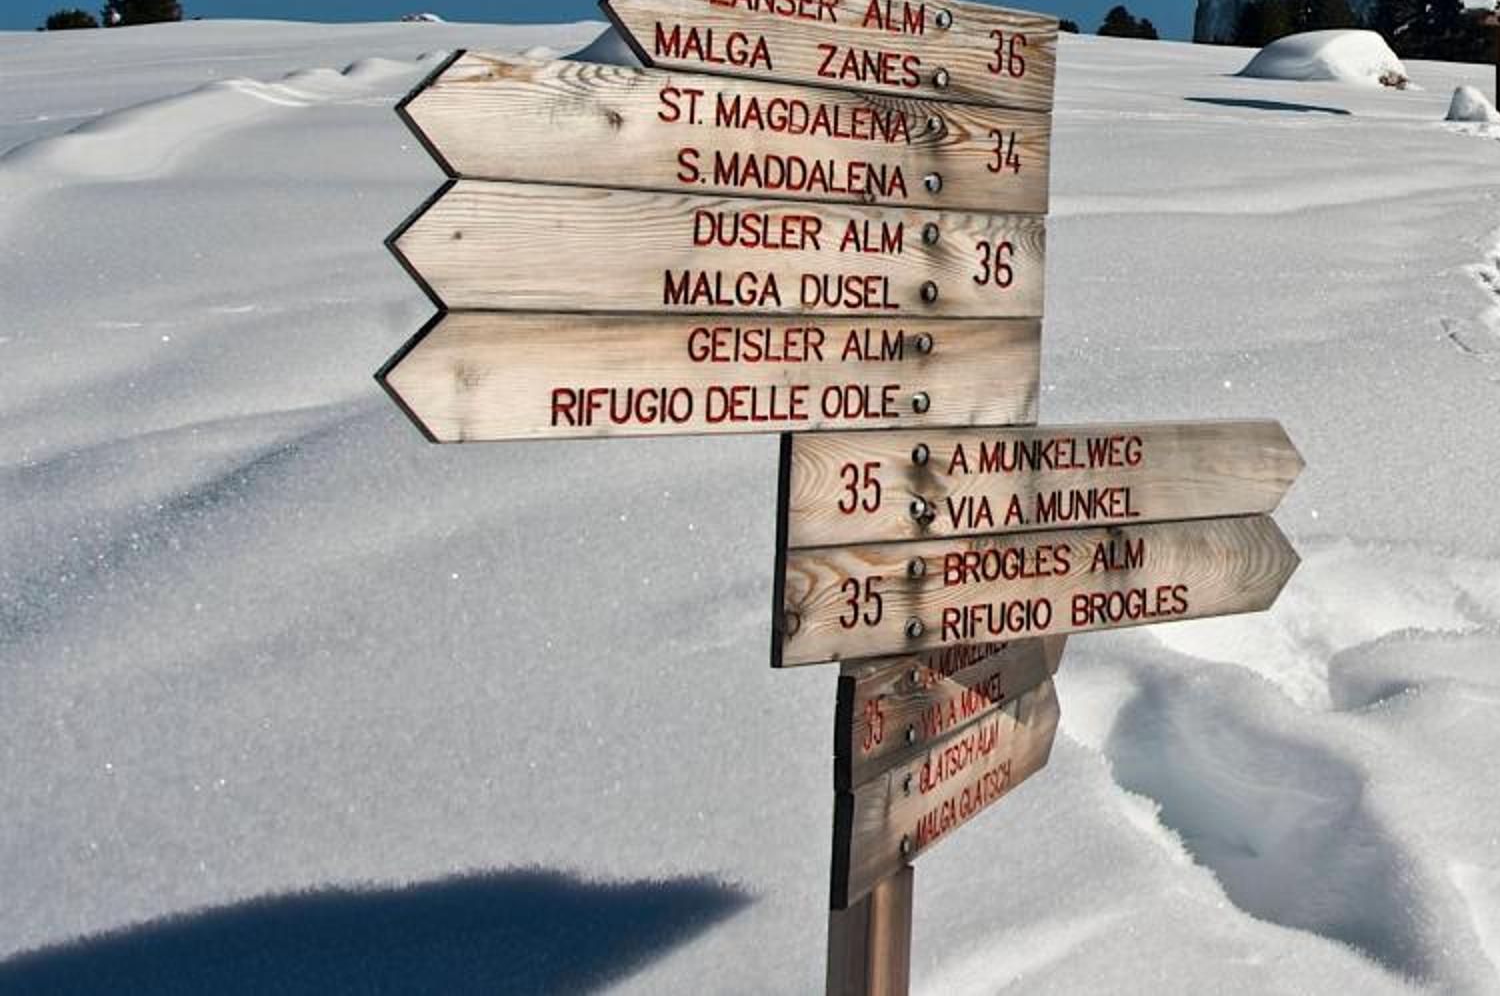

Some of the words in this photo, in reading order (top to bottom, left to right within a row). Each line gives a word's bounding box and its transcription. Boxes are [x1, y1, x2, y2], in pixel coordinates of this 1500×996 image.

[655, 21, 773, 71] MALGA
[817, 43, 921, 89] ZANES
[987, 29, 1028, 79] 36
[658, 87, 704, 125] ST.
[715, 92, 911, 145] MAGDALENA
[677, 147, 707, 185] S.
[713, 150, 908, 198] MADDALENA
[987, 128, 1021, 175] 34
[693, 210, 822, 251] DUSLER
[839, 219, 904, 254] ALM
[663, 269, 781, 307] MALGA
[801, 273, 900, 309] DUSEL
[973, 240, 1015, 288] 36
[687, 326, 825, 363] GEISLER
[841, 327, 903, 362] ALM
[550, 386, 693, 427] RIFUGIO
[705, 384, 810, 423] DELLE
[821, 384, 901, 419] ODLE
[838, 461, 881, 515] 35
[946, 495, 994, 529] VIA
[1036, 487, 1141, 525] MUNKEL
[943, 544, 1071, 587] BROGLES
[1091, 537, 1145, 573] ALM
[839, 575, 883, 629] 35
[940, 598, 1053, 642] RIFUGIO
[1070, 584, 1189, 627] BROGLES
[862, 694, 886, 751] 35
[975, 717, 999, 761] ALM
[914, 796, 957, 853] MALGA
